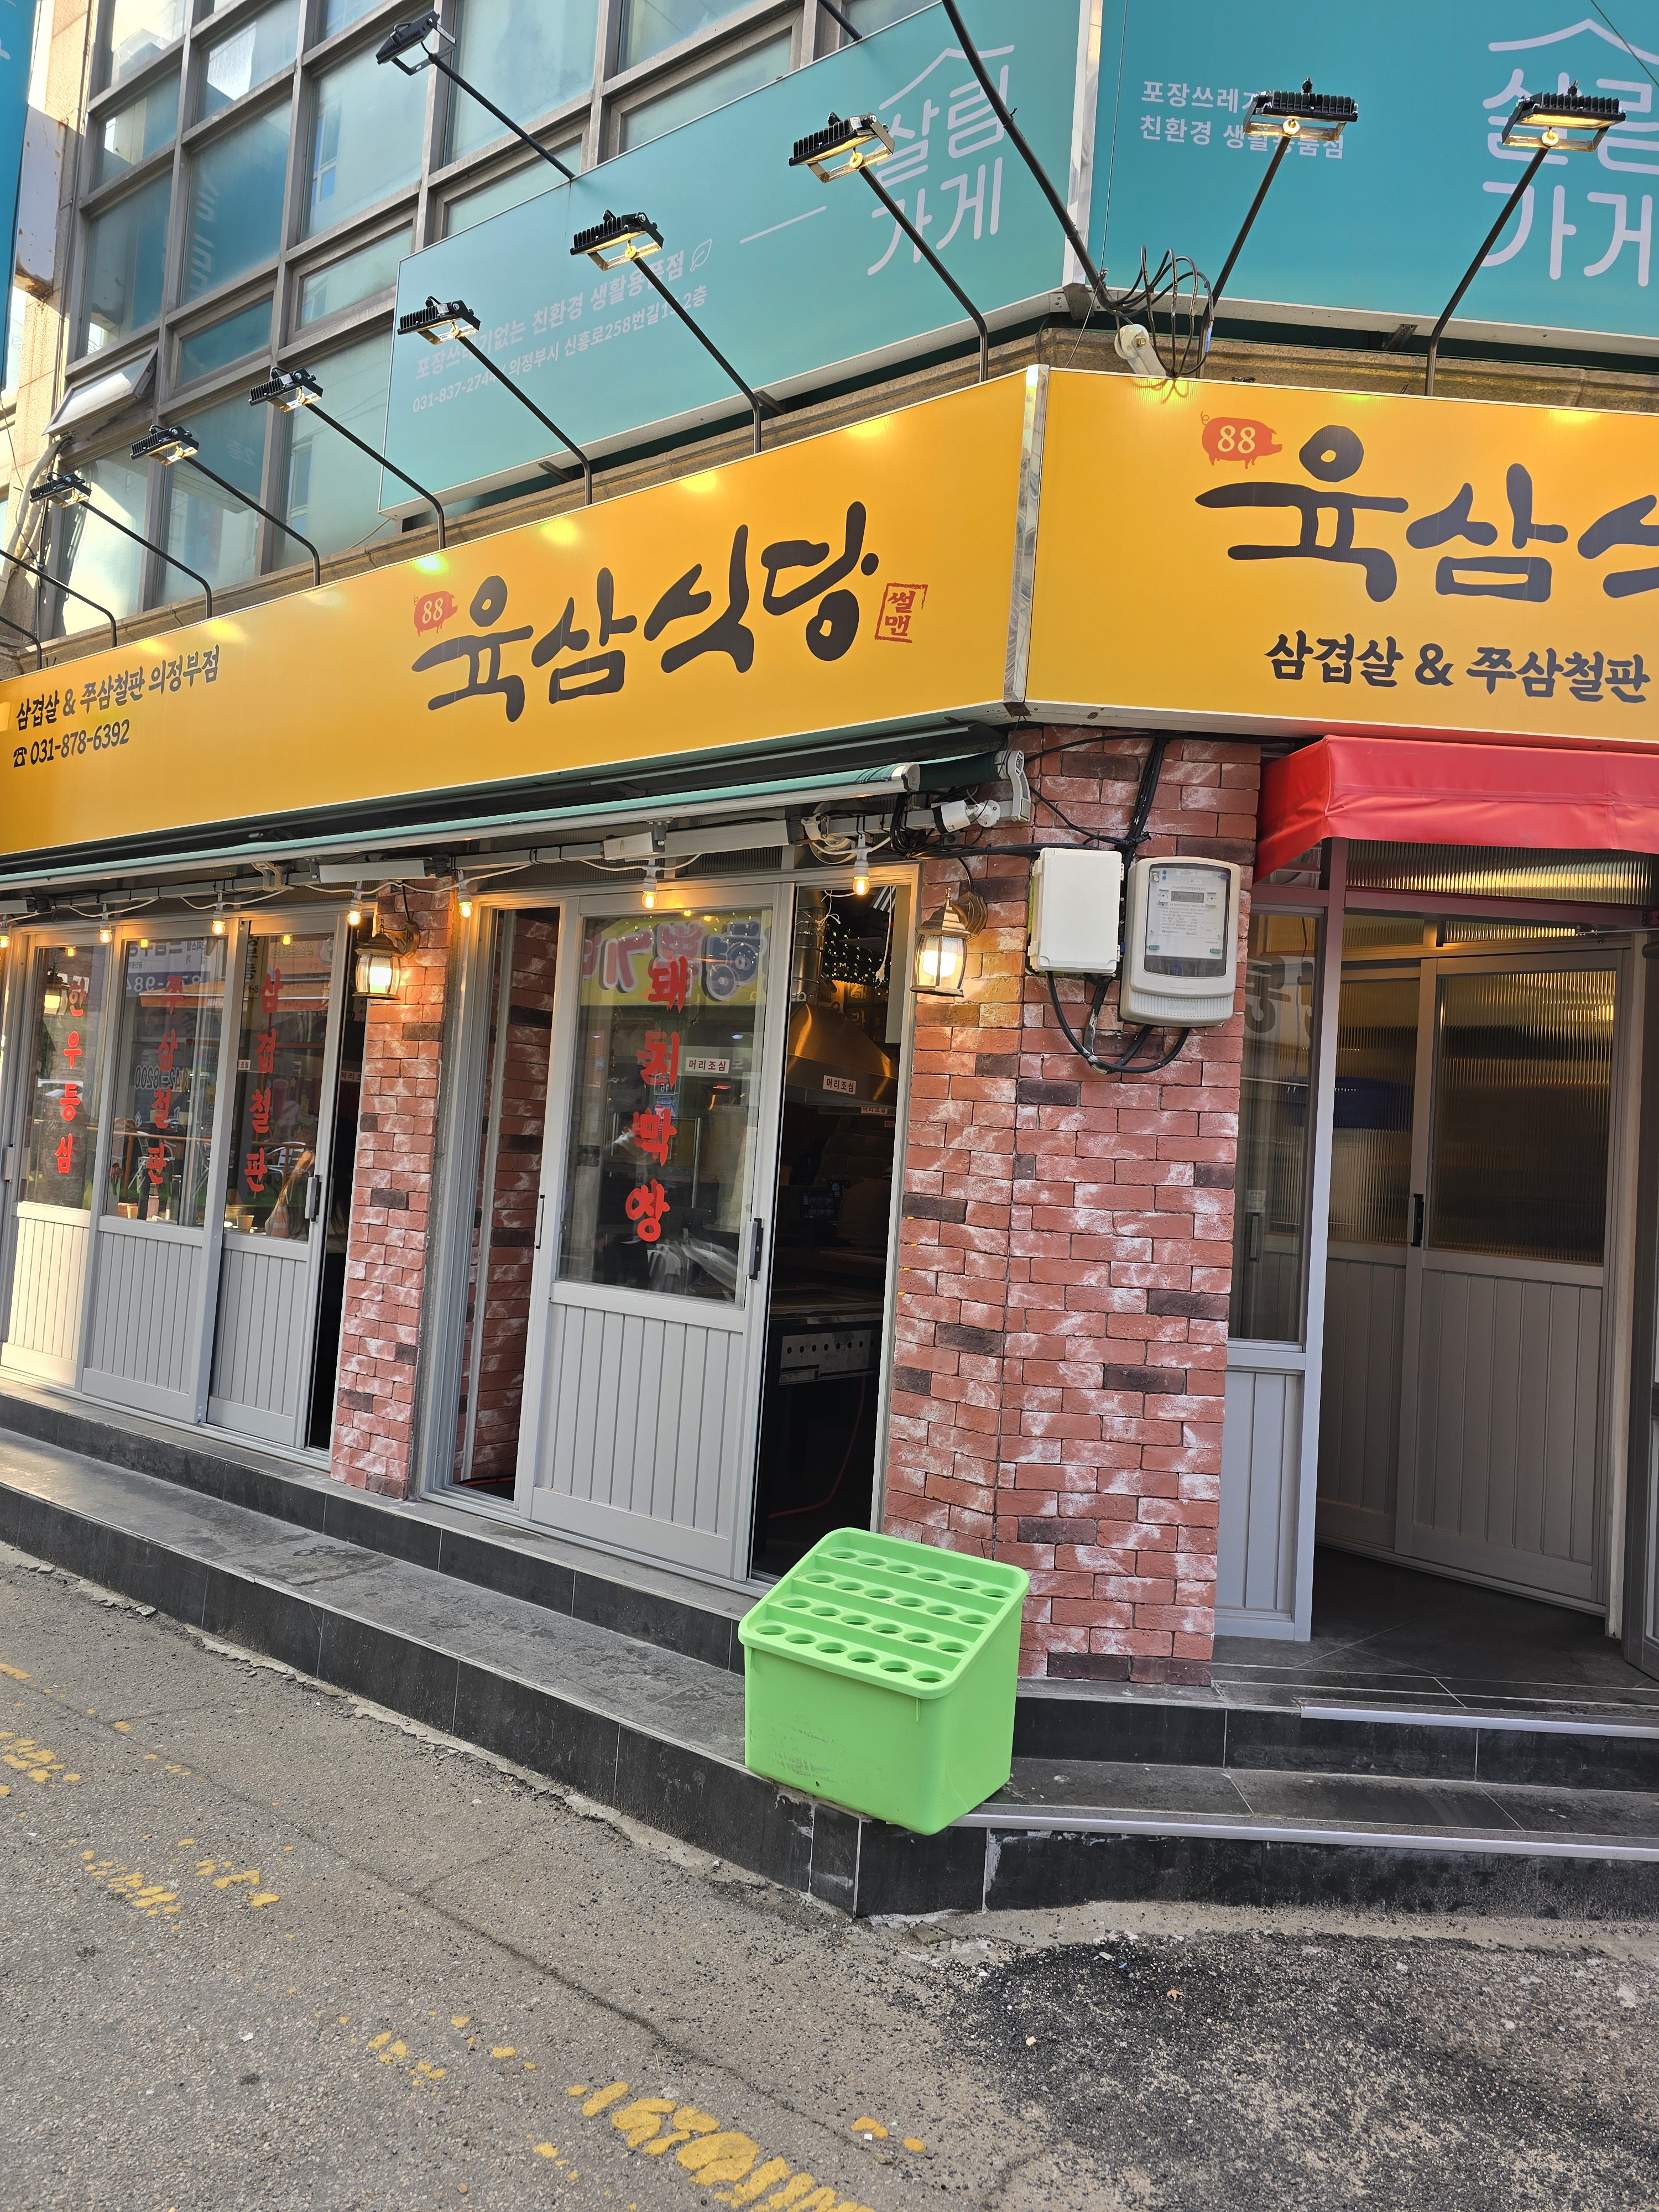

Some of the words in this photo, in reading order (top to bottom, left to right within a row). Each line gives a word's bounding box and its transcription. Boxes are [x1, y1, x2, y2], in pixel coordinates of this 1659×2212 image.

[1140, 115, 1212, 146] 친환경
[867, 157, 1003, 275] 가게
[508, 342, 559, 375] 의정부시
[683, 285, 707, 310] 2층
[532, 292, 583, 335] 친환경
[1217, 424, 1256, 455] 88
[411, 500, 879, 722] 육삼식당
[422, 594, 444, 623] 88
[16, 690, 60, 731] 삼겹살
[62, 688, 76, 717] &
[80, 666, 145, 714] 쭈삼철판
[149, 644, 220, 695] 의정부점
[1264, 629, 1404, 688] 삼겹살
[1415, 643, 1454, 687] &
[1466, 646, 1651, 703] 쭈삼철판
[30, 719, 131, 765] 031-878-6392
[55, 977, 87, 1174] 한우등심
[243, 968, 283, 1193] 삼겹철판
[688, 1059, 727, 1072] 머리조심
[826, 1078, 854, 1093] 머리조심
